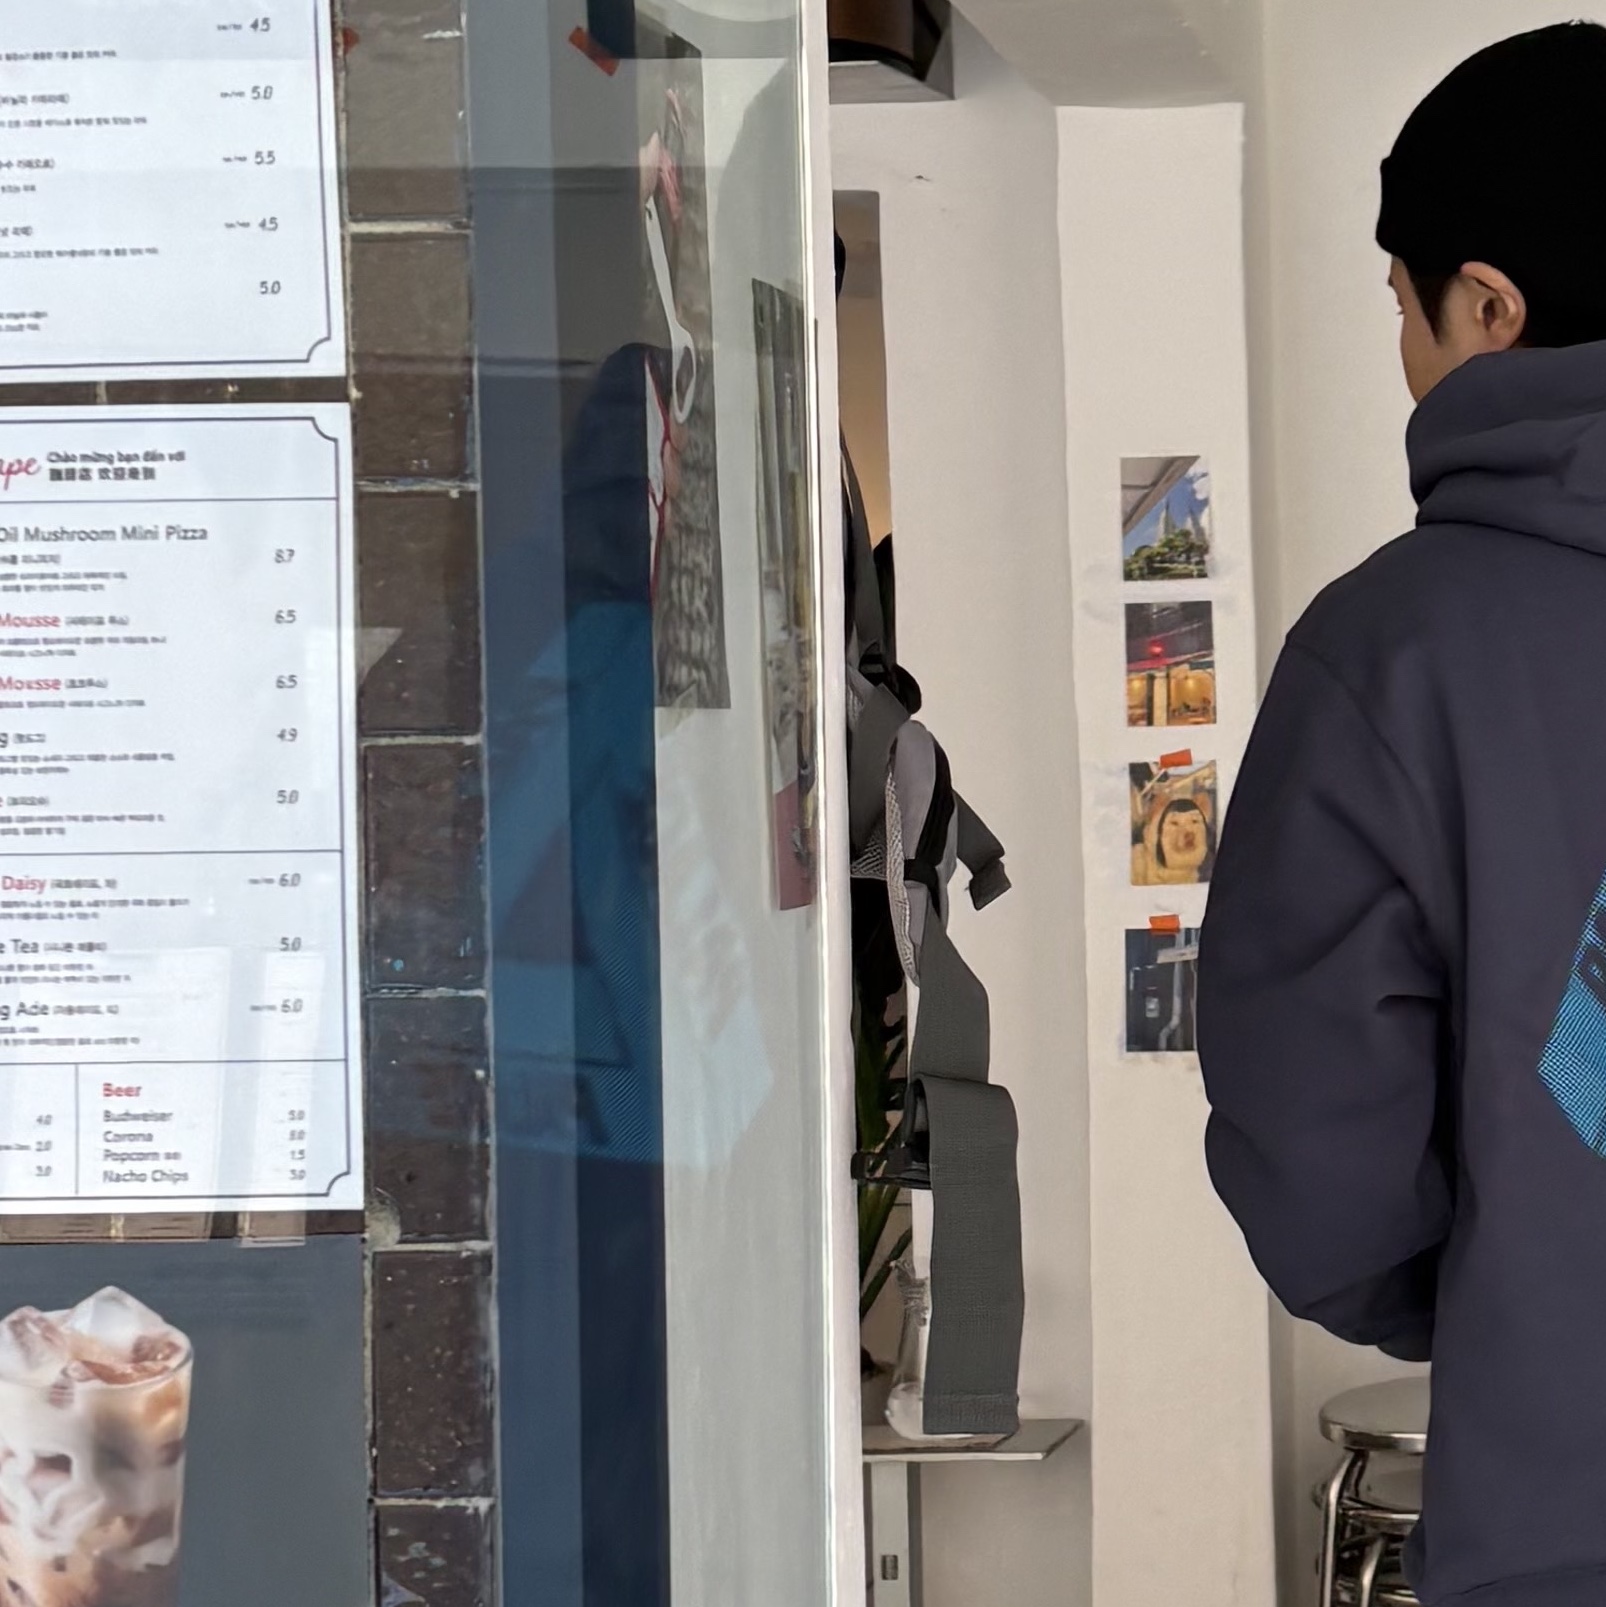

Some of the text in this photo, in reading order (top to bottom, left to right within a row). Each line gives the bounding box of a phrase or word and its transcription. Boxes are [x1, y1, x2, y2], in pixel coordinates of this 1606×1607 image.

[251, 85, 273, 100] 5.0
[254, 150, 276, 165] 5.5
[259, 280, 281, 295] 5.0
[24, 525, 116, 542] Mushroom
[121, 524, 159, 541] Mini
[165, 524, 208, 541] Pizza
[2, 875, 46, 894] Daisy
[10, 938, 39, 953] Tea
[16, 1002, 49, 1015] Ade
[103, 1083, 142, 1097] Beer
[103, 1110, 173, 1122] Budweiser
[103, 1130, 153, 1143] Corona
[103, 1150, 160, 1163] Popcorn
[103, 1170, 147, 1183] Nacho
[151, 1170, 189, 1185] Chips
